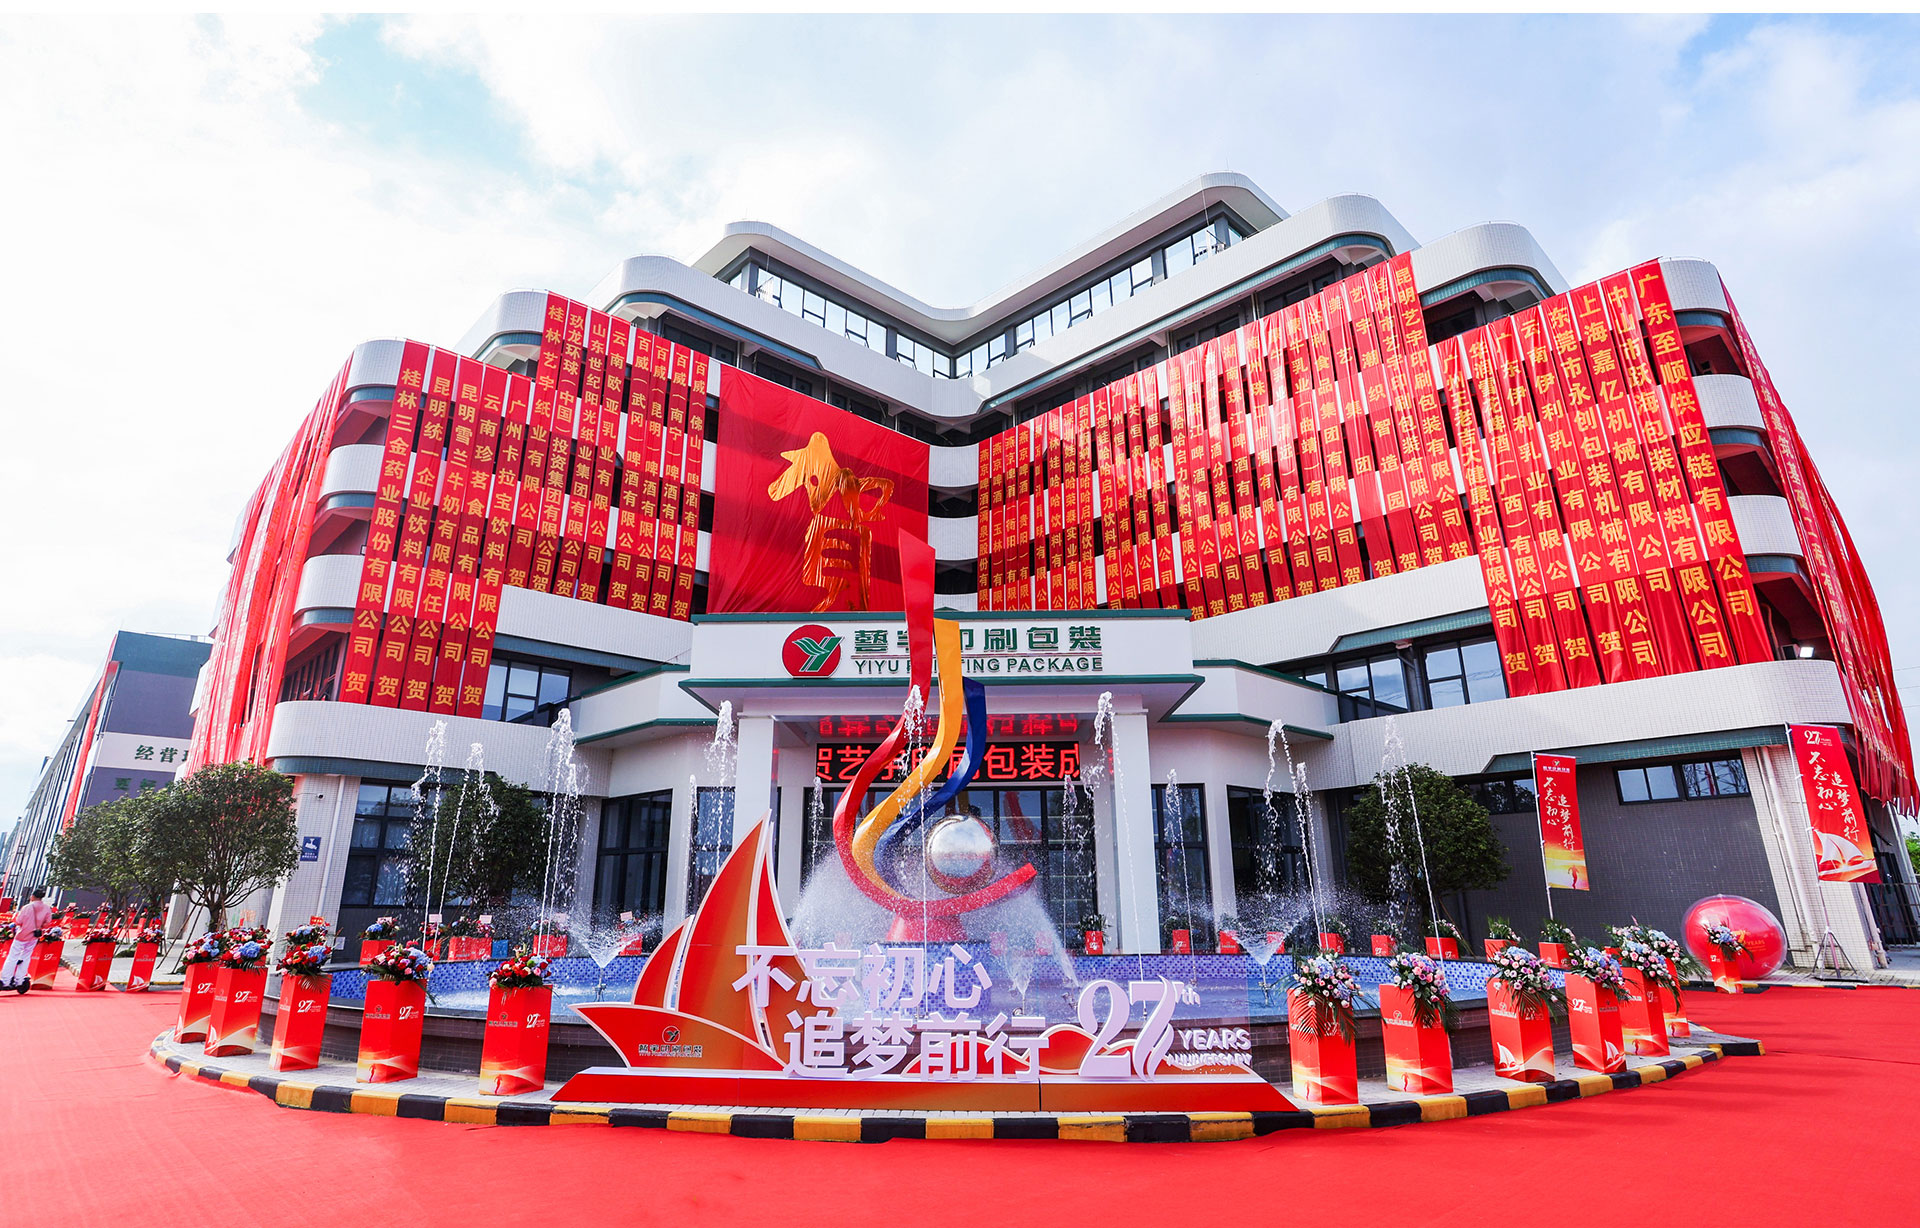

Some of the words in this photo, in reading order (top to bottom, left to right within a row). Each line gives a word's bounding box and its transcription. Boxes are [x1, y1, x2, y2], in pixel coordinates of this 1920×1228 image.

[855, 659, 899, 674] YIYU
[1007, 656, 1103, 673] PACKAGE
[733, 943, 992, 1008] 不忘初心
[782, 1011, 1050, 1080] 追梦前行
[1178, 1027, 1252, 1050] YEARS
